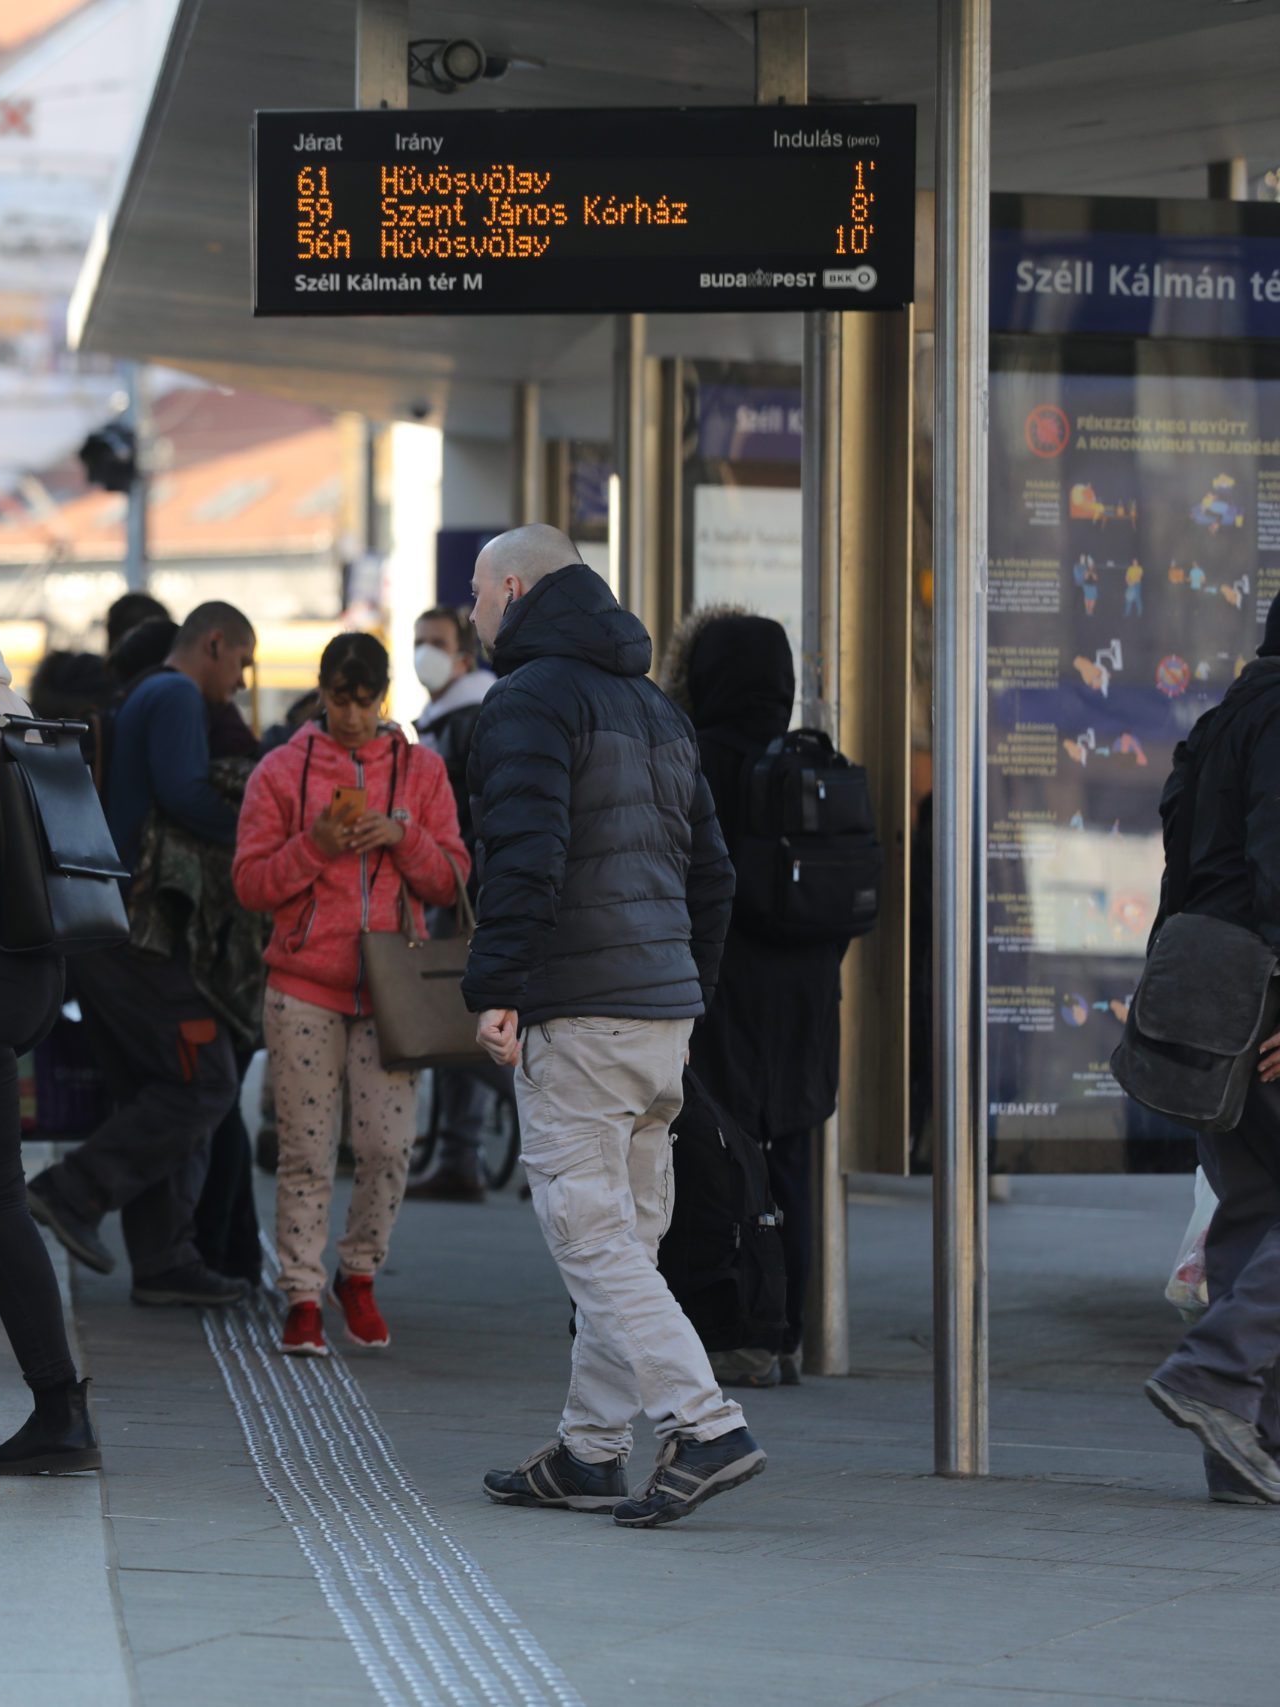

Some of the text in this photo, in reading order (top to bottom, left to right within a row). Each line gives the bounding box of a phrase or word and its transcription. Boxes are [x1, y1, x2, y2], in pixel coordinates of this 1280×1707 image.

[293, 129, 880, 155] Járat Irány Indulás (perc)
[297, 166, 330, 196] 61
[381, 165, 550, 195] Hűvösvölgy
[297, 198, 333, 227] 59
[381, 197, 467, 227] Szent
[482, 196, 568, 226] János
[583, 195, 688, 225] Kórház
[297, 229, 351, 259] 56A
[381, 228, 550, 258] Hűvösvölgy
[294, 272, 483, 291] Széll Kálmán tér M
[829, 273, 853, 283] BKK
[1016, 260, 1093, 294] Széll
[1108, 263, 1236, 300] Kálmán
[1155, 418, 1187, 433] MEG
[1075, 436, 1087, 450] A
[1090, 435, 1195, 453] KORONAVÍRUS
